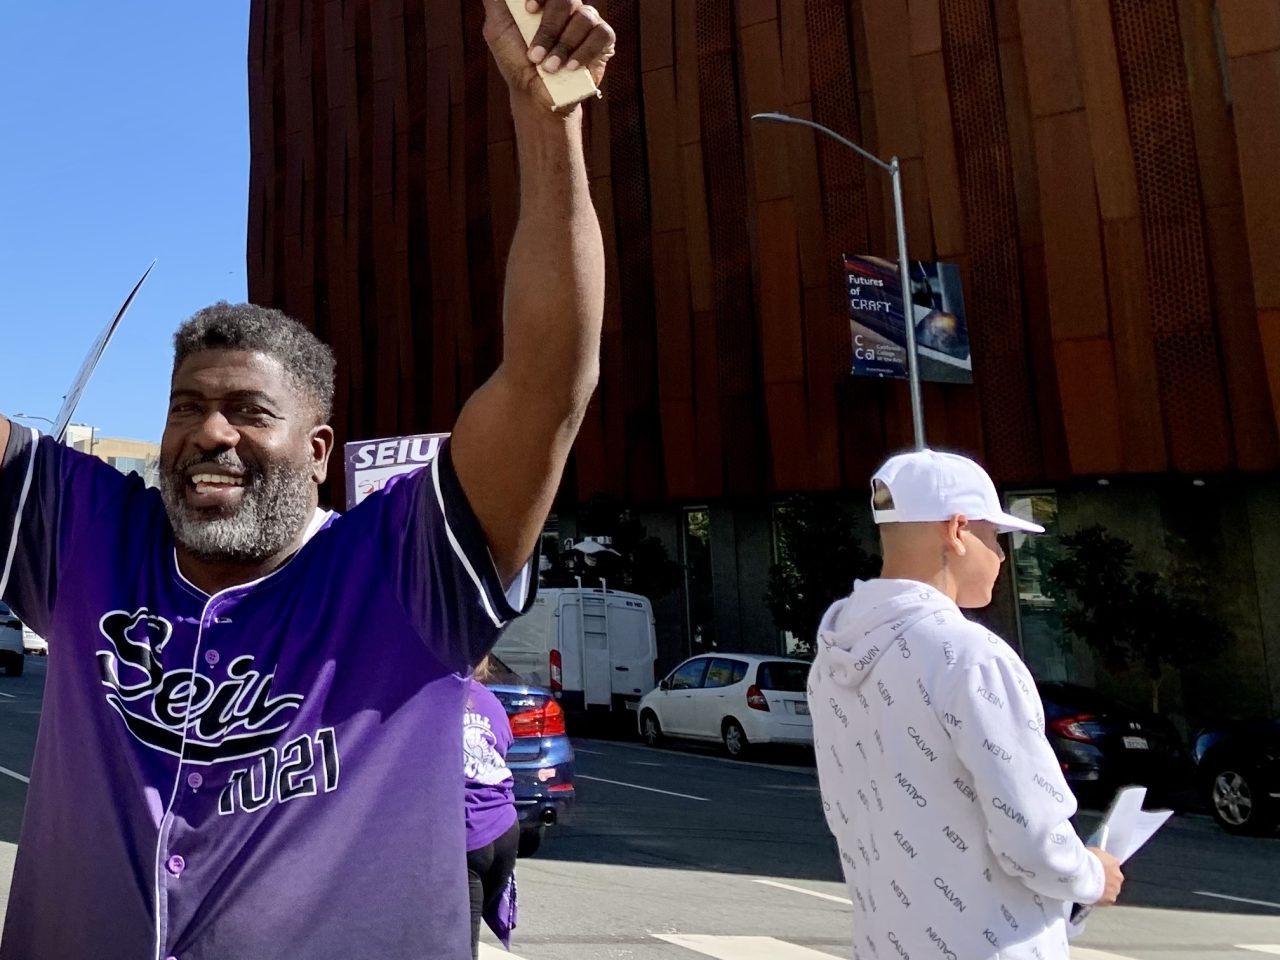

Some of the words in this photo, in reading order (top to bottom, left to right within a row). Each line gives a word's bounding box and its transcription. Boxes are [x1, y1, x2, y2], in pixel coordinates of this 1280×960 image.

[848, 274, 884, 287] Futures
[850, 286, 861, 296] of
[851, 298, 892, 313] CRAFT
[355, 437, 440, 469] SEIU
[854, 645, 881, 672] CALVIN
[943, 640, 957, 666] KLEIN
[877, 679, 895, 707] KLEIN
[977, 685, 1005, 710] KLEIN
[907, 726, 938, 762] CALVIN
[982, 738, 1013, 764] KLEIN
[219, 727, 341, 816] 1021
[894, 772, 928, 808] CALVIN
[953, 777, 978, 803] KLEIN
[1033, 773, 1065, 804] CALVIN
[991, 796, 1030, 829] CALVIN
[893, 829, 918, 859] KLEIN
[942, 825, 969, 853] KLEIN
[890, 879, 912, 909] KLEIN
[933, 876, 967, 913] CALVIN
[926, 926, 958, 960] CALVIN
